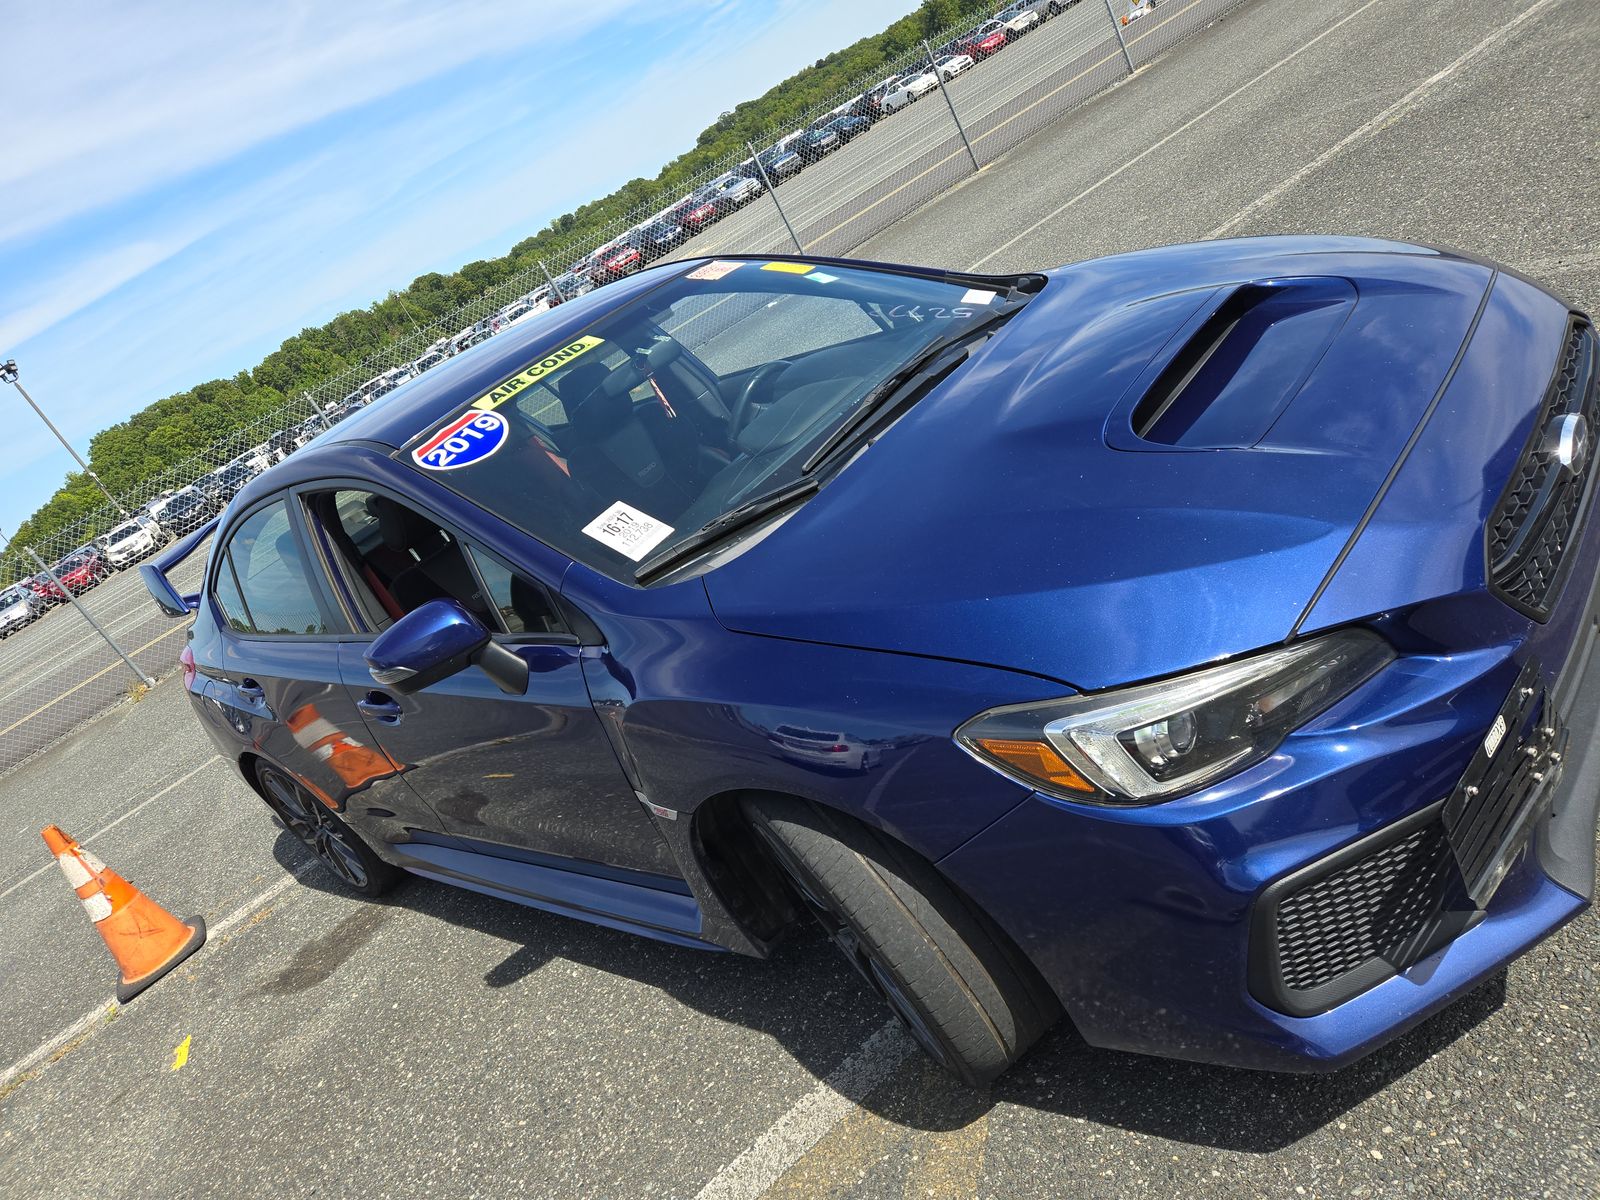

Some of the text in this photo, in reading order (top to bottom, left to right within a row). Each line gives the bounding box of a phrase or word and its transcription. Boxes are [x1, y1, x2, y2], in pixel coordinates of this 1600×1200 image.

[488, 342, 591, 404] AIR COND.
[427, 415, 501, 467] 2019
[602, 511, 635, 537] 16:17
[619, 521, 640, 539] 2019
